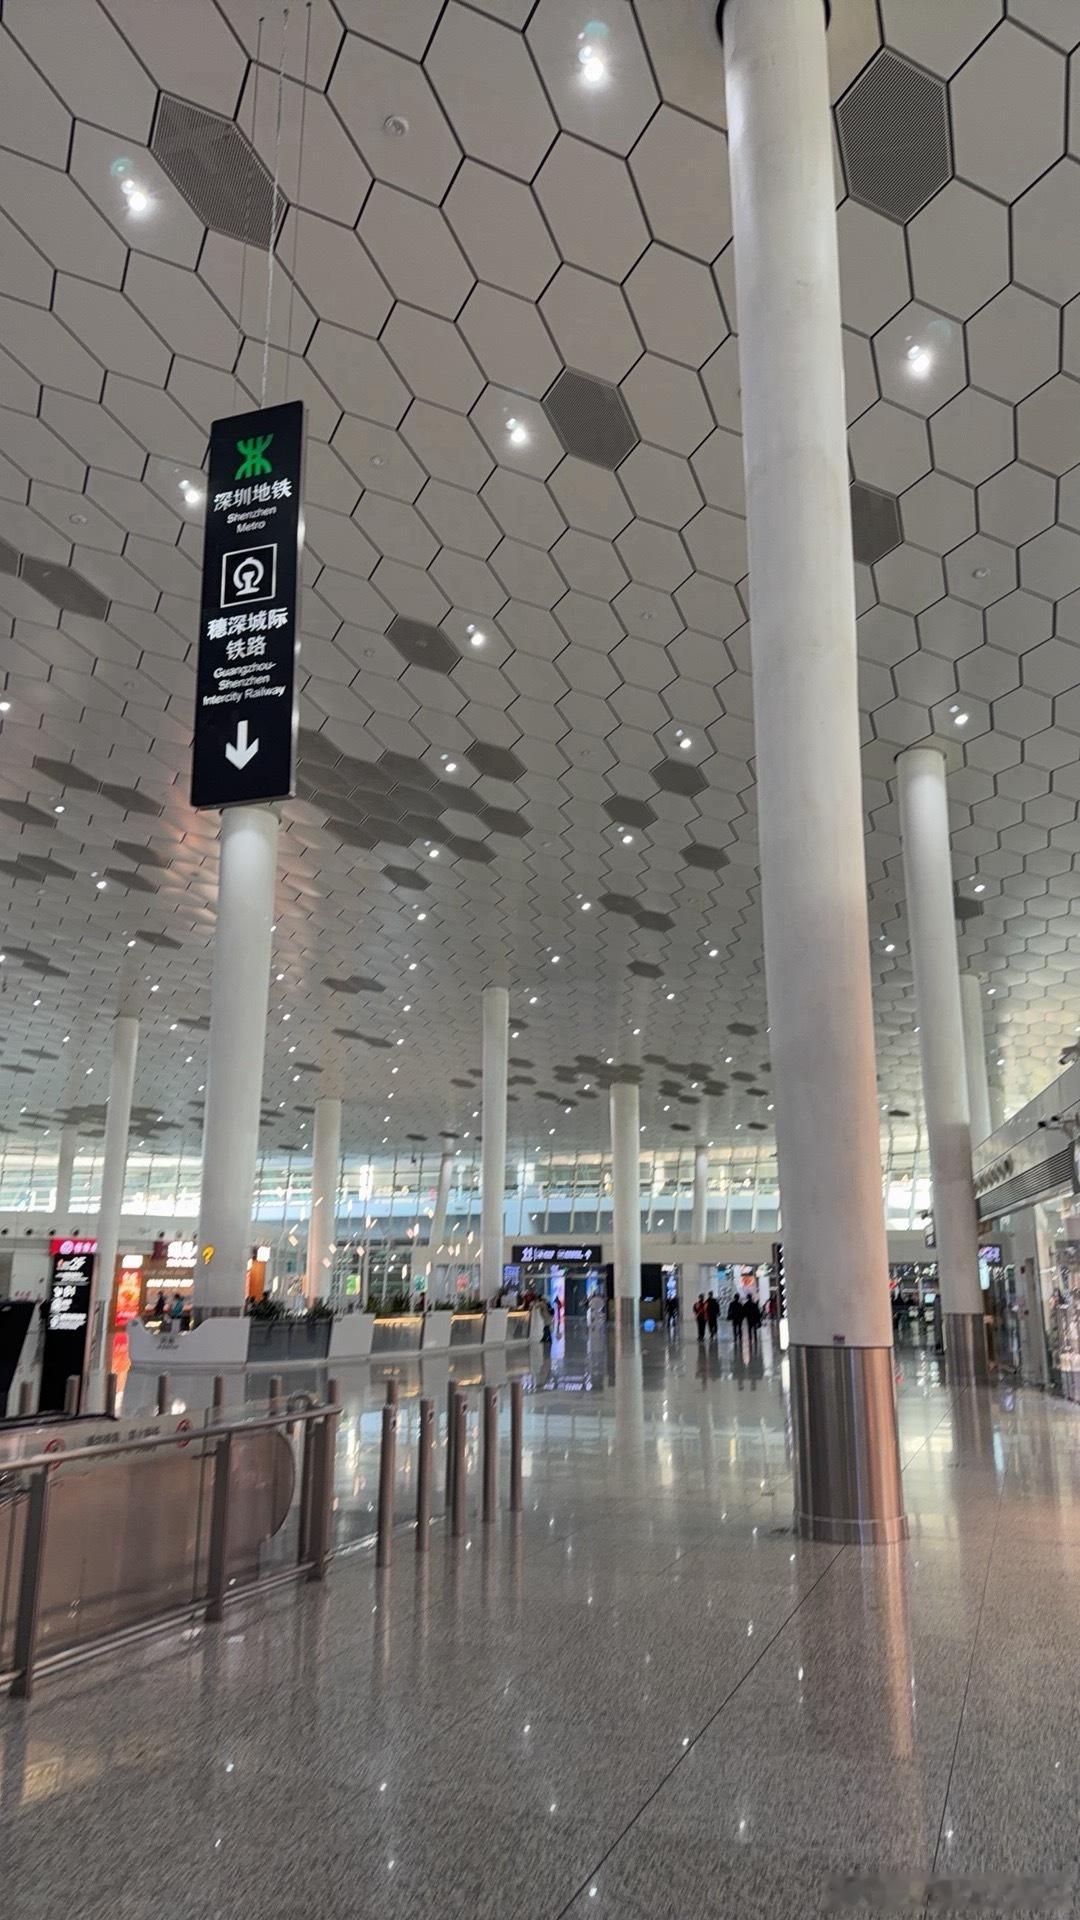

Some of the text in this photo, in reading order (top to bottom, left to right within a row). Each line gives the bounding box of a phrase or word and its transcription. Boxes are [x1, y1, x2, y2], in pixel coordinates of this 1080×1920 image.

[213, 478, 293, 512] 深圳地铁
[226, 506, 277, 524] Shenzhen
[236, 521, 267, 534] Metro
[206, 607, 289, 641] 穗深城际
[225, 634, 267, 661] 铁路
[213, 661, 277, 679] Guangzhou-
[218, 674, 271, 691] Shenzhen
[202, 685, 286, 706] Intercity Railway
